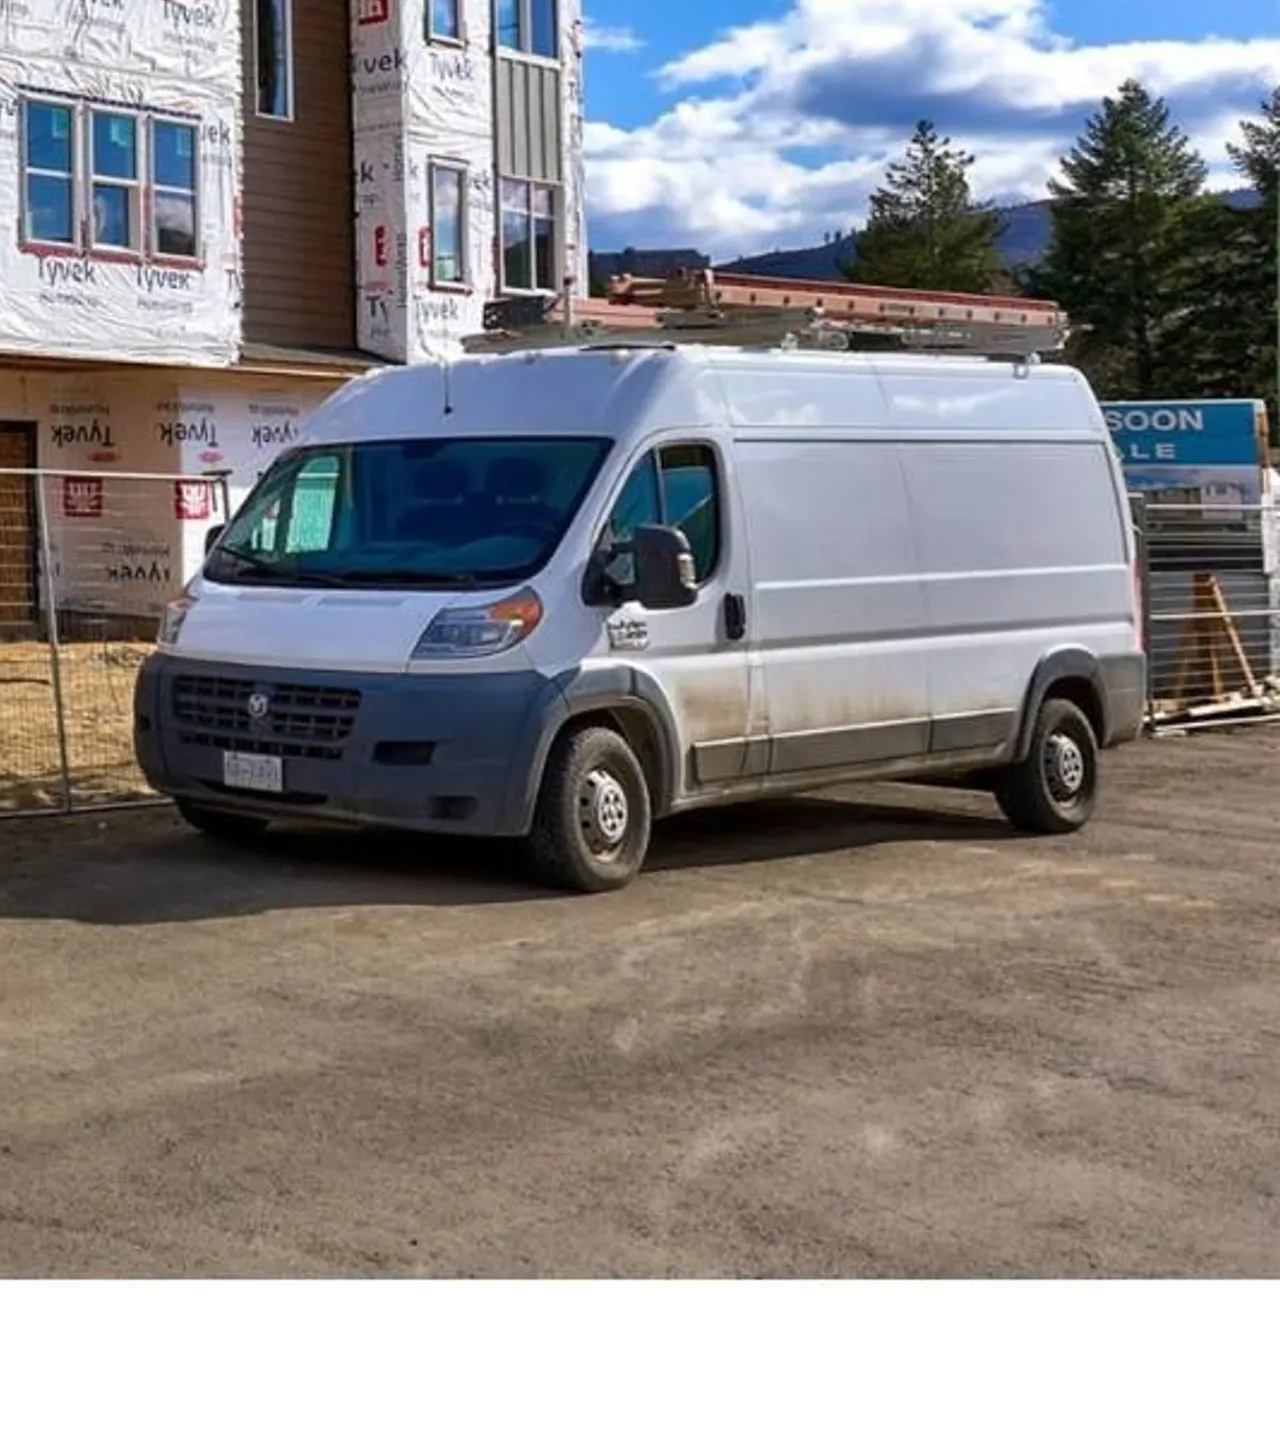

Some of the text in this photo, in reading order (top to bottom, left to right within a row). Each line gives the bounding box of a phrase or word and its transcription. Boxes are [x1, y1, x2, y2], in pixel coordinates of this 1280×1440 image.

[1105, 410, 1204, 431] SOON
[52, 424, 115, 448] Tyvek
[159, 422, 218, 448] Tyvek
